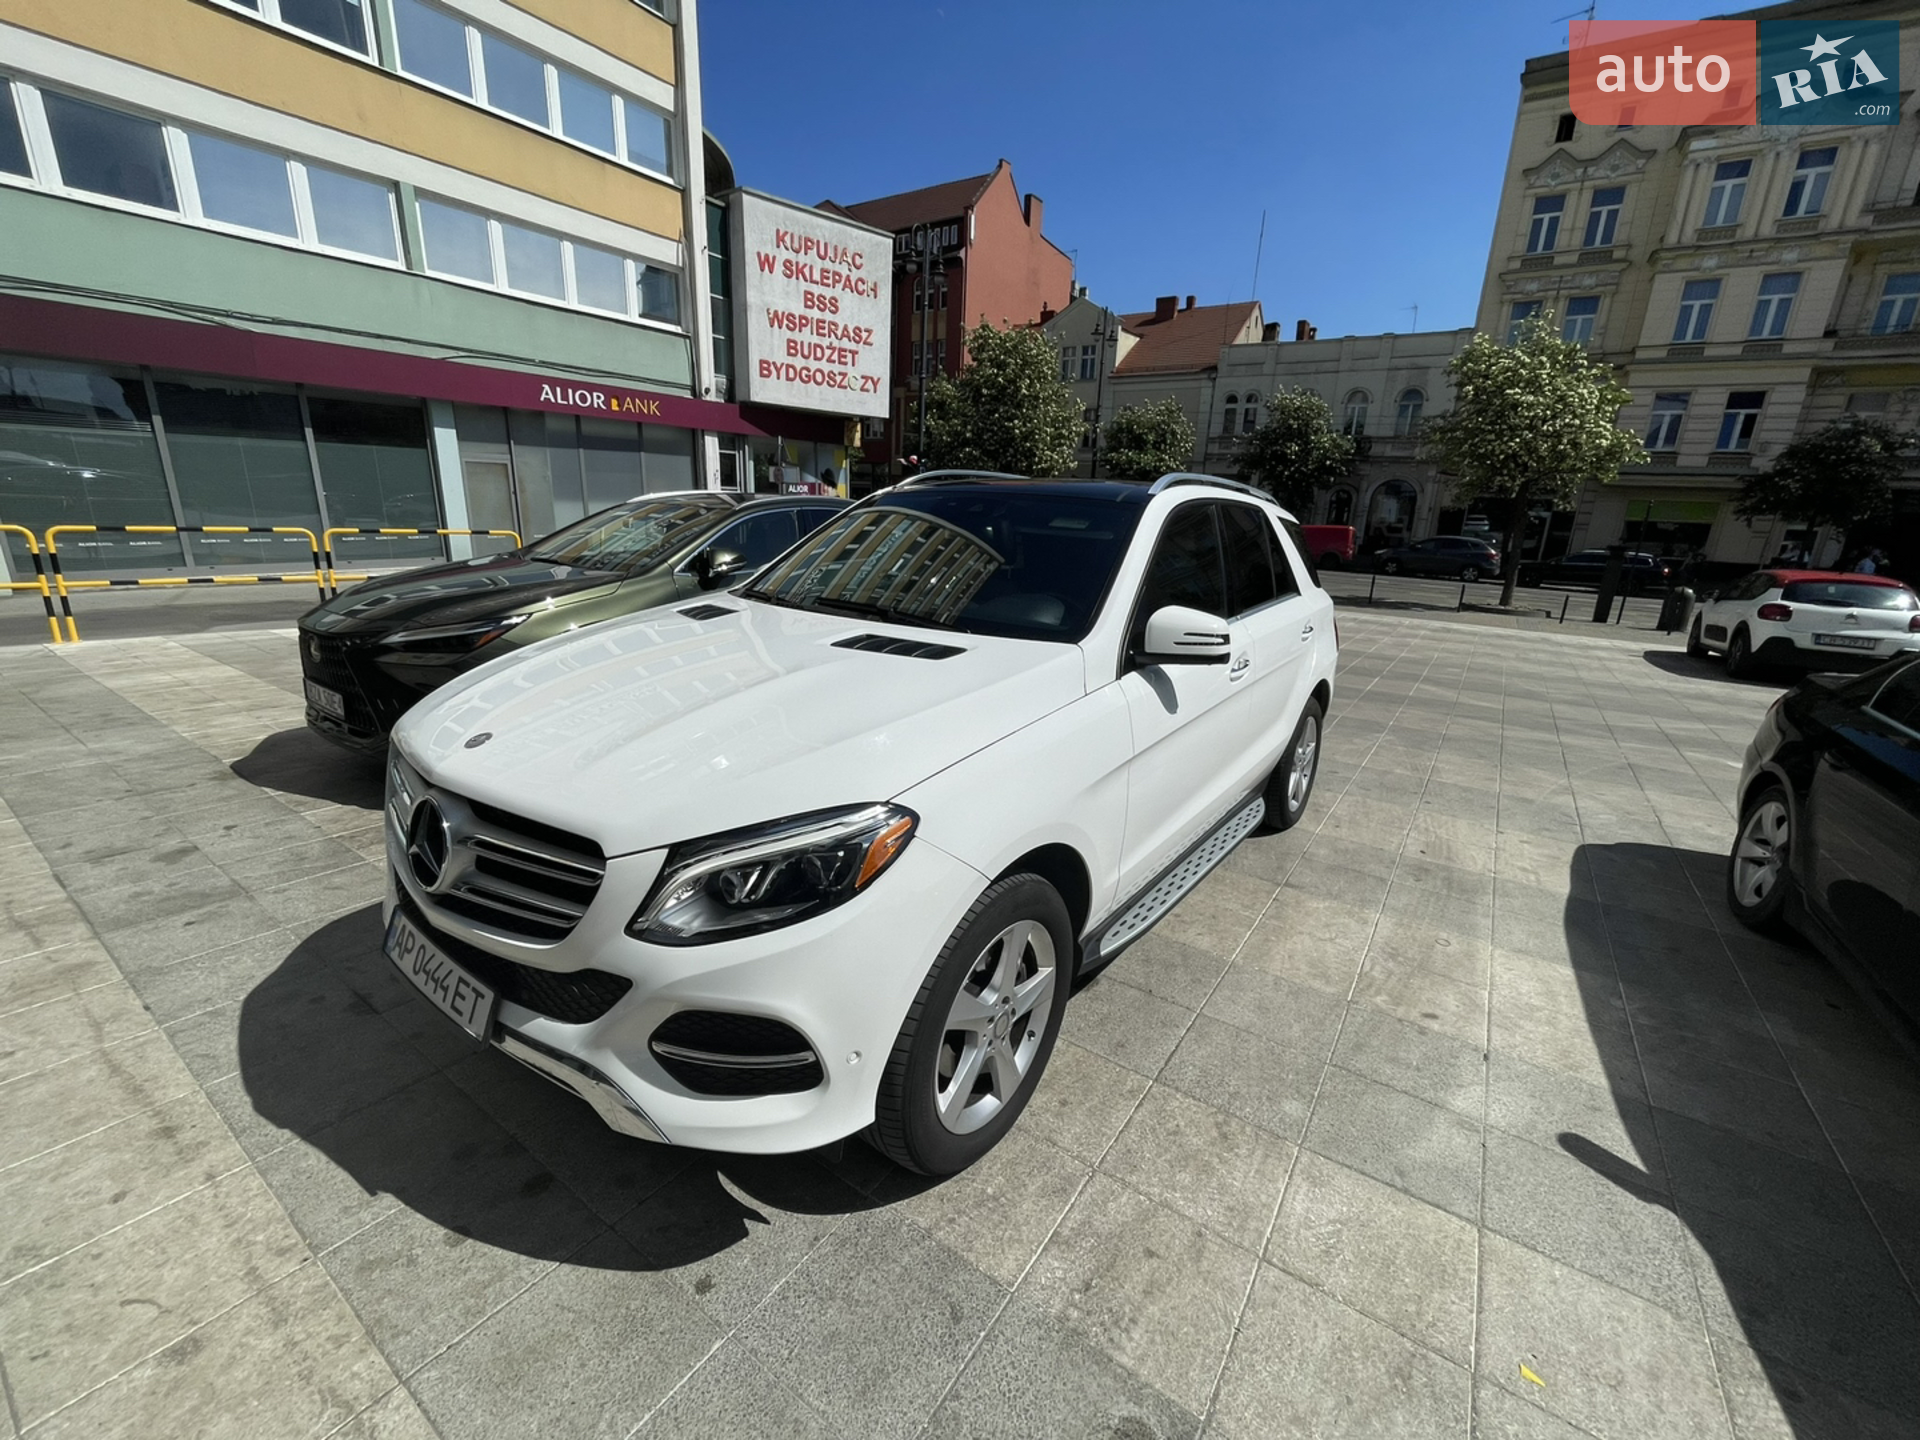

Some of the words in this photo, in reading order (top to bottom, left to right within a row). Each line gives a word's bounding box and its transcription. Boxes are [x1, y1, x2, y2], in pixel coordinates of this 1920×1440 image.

[776, 228, 864, 272] KUPUJĄC
[757, 251, 776, 274] W
[782, 258, 878, 299] SKLEPACH
[803, 290, 840, 315] BSS
[766, 308, 874, 346] WSPIERASZ
[786, 338, 859, 367] BUDŻET
[759, 359, 881, 394] BYDGOSZCZY
[540, 384, 607, 410] ALIOR
[788, 484, 808, 493] ALIOR
